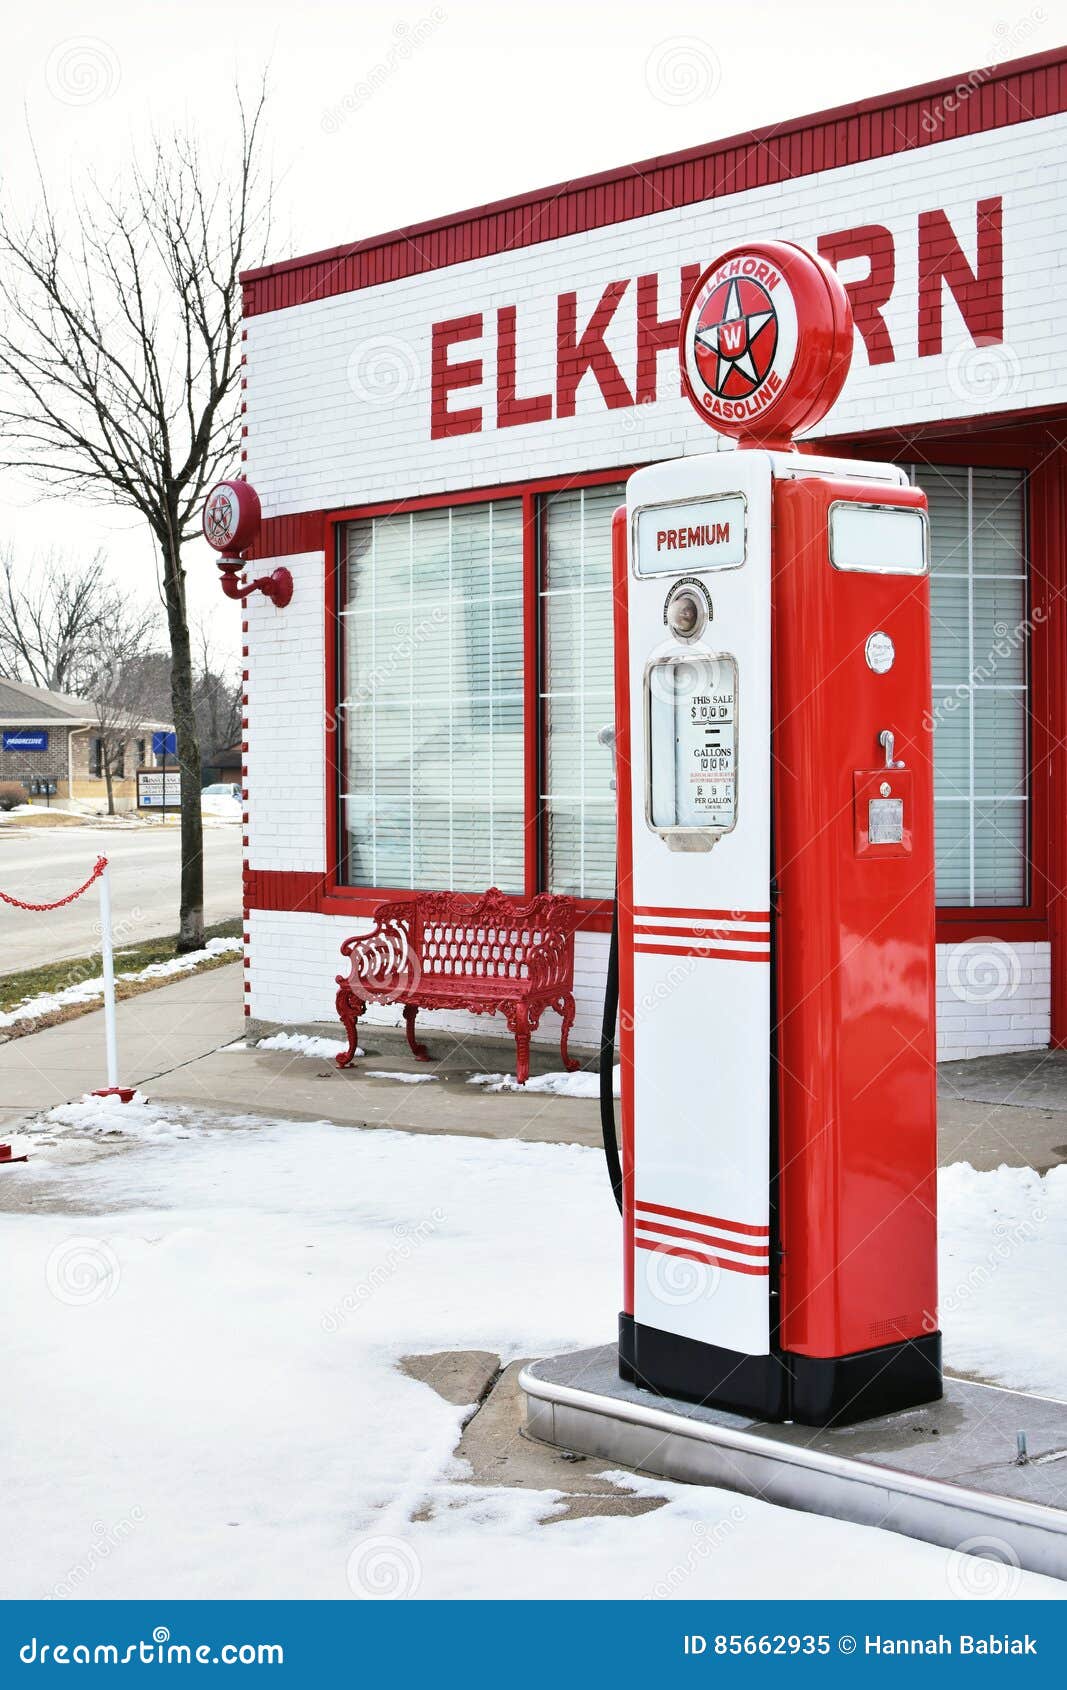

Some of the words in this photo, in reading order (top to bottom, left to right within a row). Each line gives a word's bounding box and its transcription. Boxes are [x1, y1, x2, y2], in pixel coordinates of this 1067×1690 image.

[696, 259, 780, 307] ELKHORN
[431, 196, 1003, 440] ELKHRN
[724, 325, 742, 350] W
[703, 370, 783, 419] GASOLINE
[656, 522, 730, 552] PREMIUM
[692, 696, 711, 705] THIS
[712, 695, 733, 704] SALE
[693, 748, 732, 758] GALLONS
